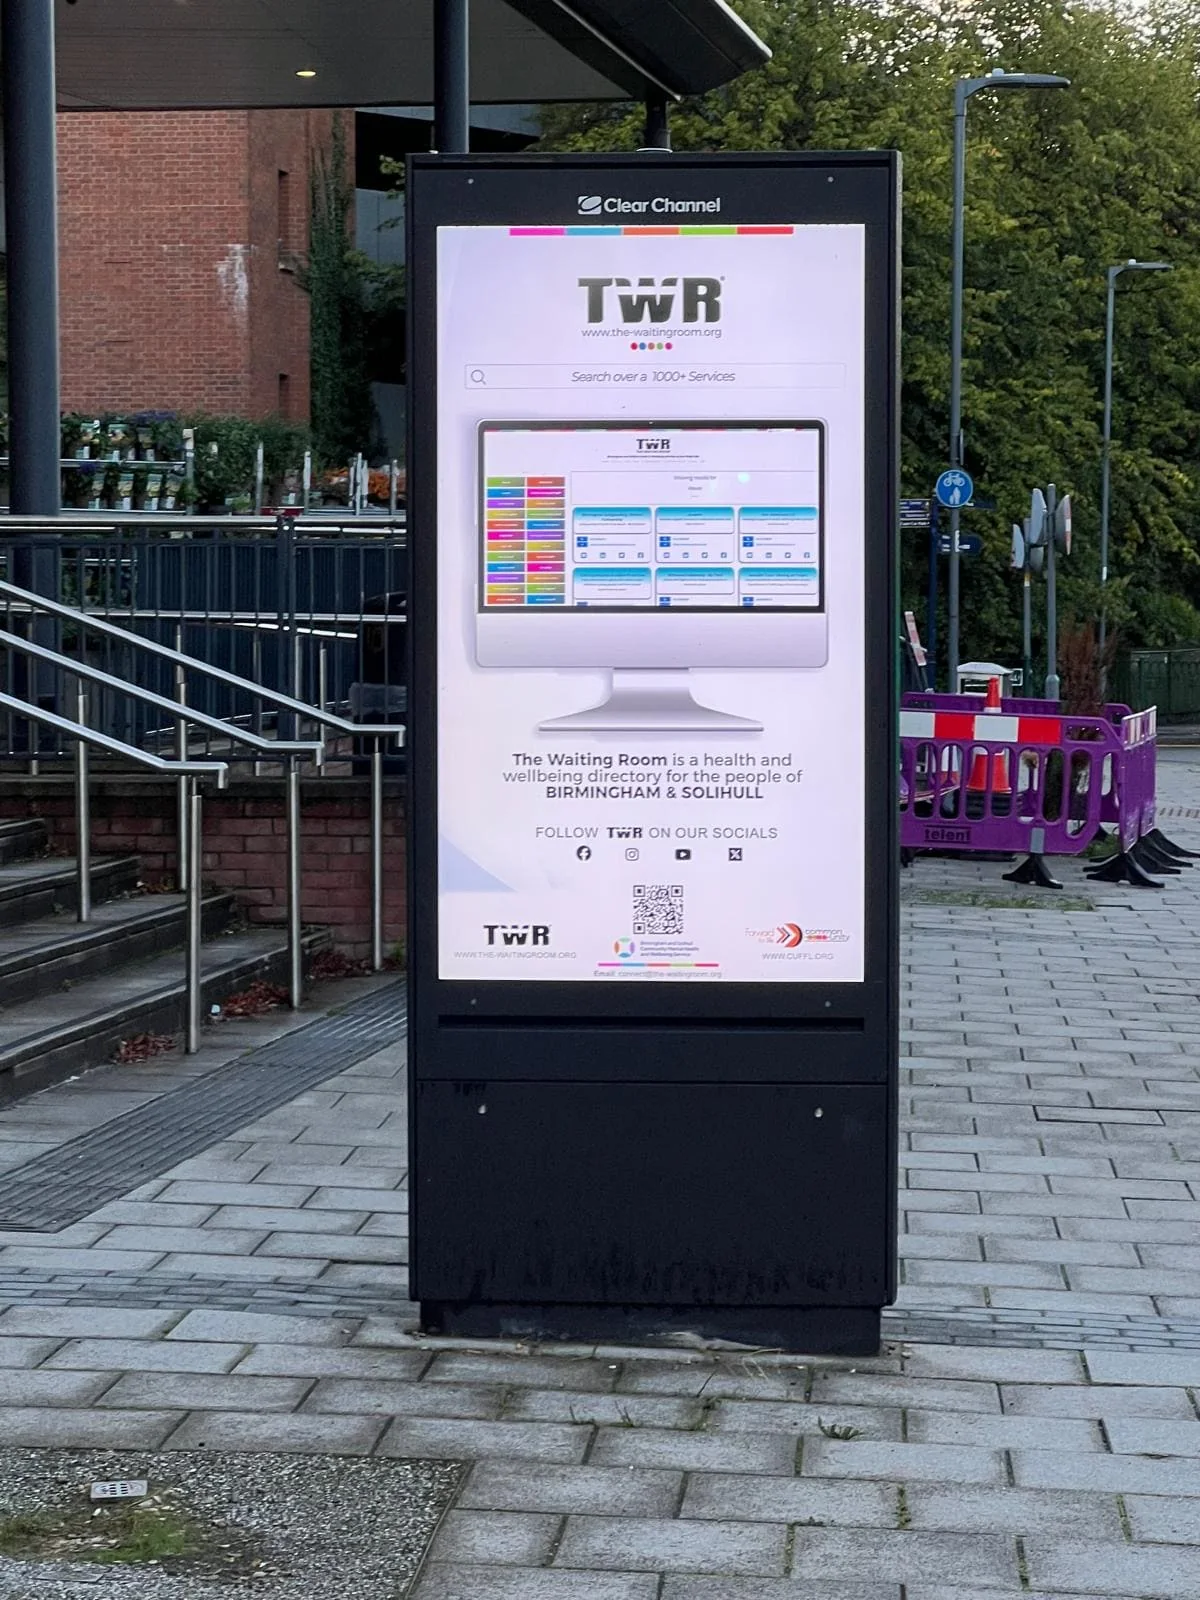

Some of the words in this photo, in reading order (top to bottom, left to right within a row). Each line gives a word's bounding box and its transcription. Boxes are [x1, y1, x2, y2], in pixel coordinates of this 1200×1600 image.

[603, 198, 649, 213] Clear
[651, 197, 721, 213] Channel
[577, 277, 722, 324] TWR
[581, 327, 722, 339] www.the-waitingroom.org
[571, 371, 613, 382] Search
[614, 373, 639, 382] over
[640, 373, 648, 382] a
[652, 371, 686, 382] 1000+
[688, 370, 736, 382] Services
[636, 438, 671, 450] TWR
[512, 753, 543, 766] The
[547, 752, 613, 769] Waiting
[618, 753, 668, 766] Room
[672, 753, 685, 766] is
[689, 756, 699, 766] a
[704, 753, 756, 766] health
[760, 753, 792, 766] and
[502, 769, 583, 785] wellbeing
[587, 769, 662, 785] directory
[666, 769, 689, 783] for
[693, 769, 720, 783] the
[725, 769, 782, 786] people
[785, 769, 803, 783] of
[546, 786, 660, 799] BIRMINGHAM
[666, 786, 677, 799] &
[681, 786, 764, 799] SOLIHULL
[535, 827, 599, 838] FOLLOW
[606, 826, 643, 839] TWR
[648, 827, 671, 839] ON
[675, 827, 708, 839] OUR
[712, 827, 778, 839] SOCIALS
[483, 924, 550, 946] TWR
